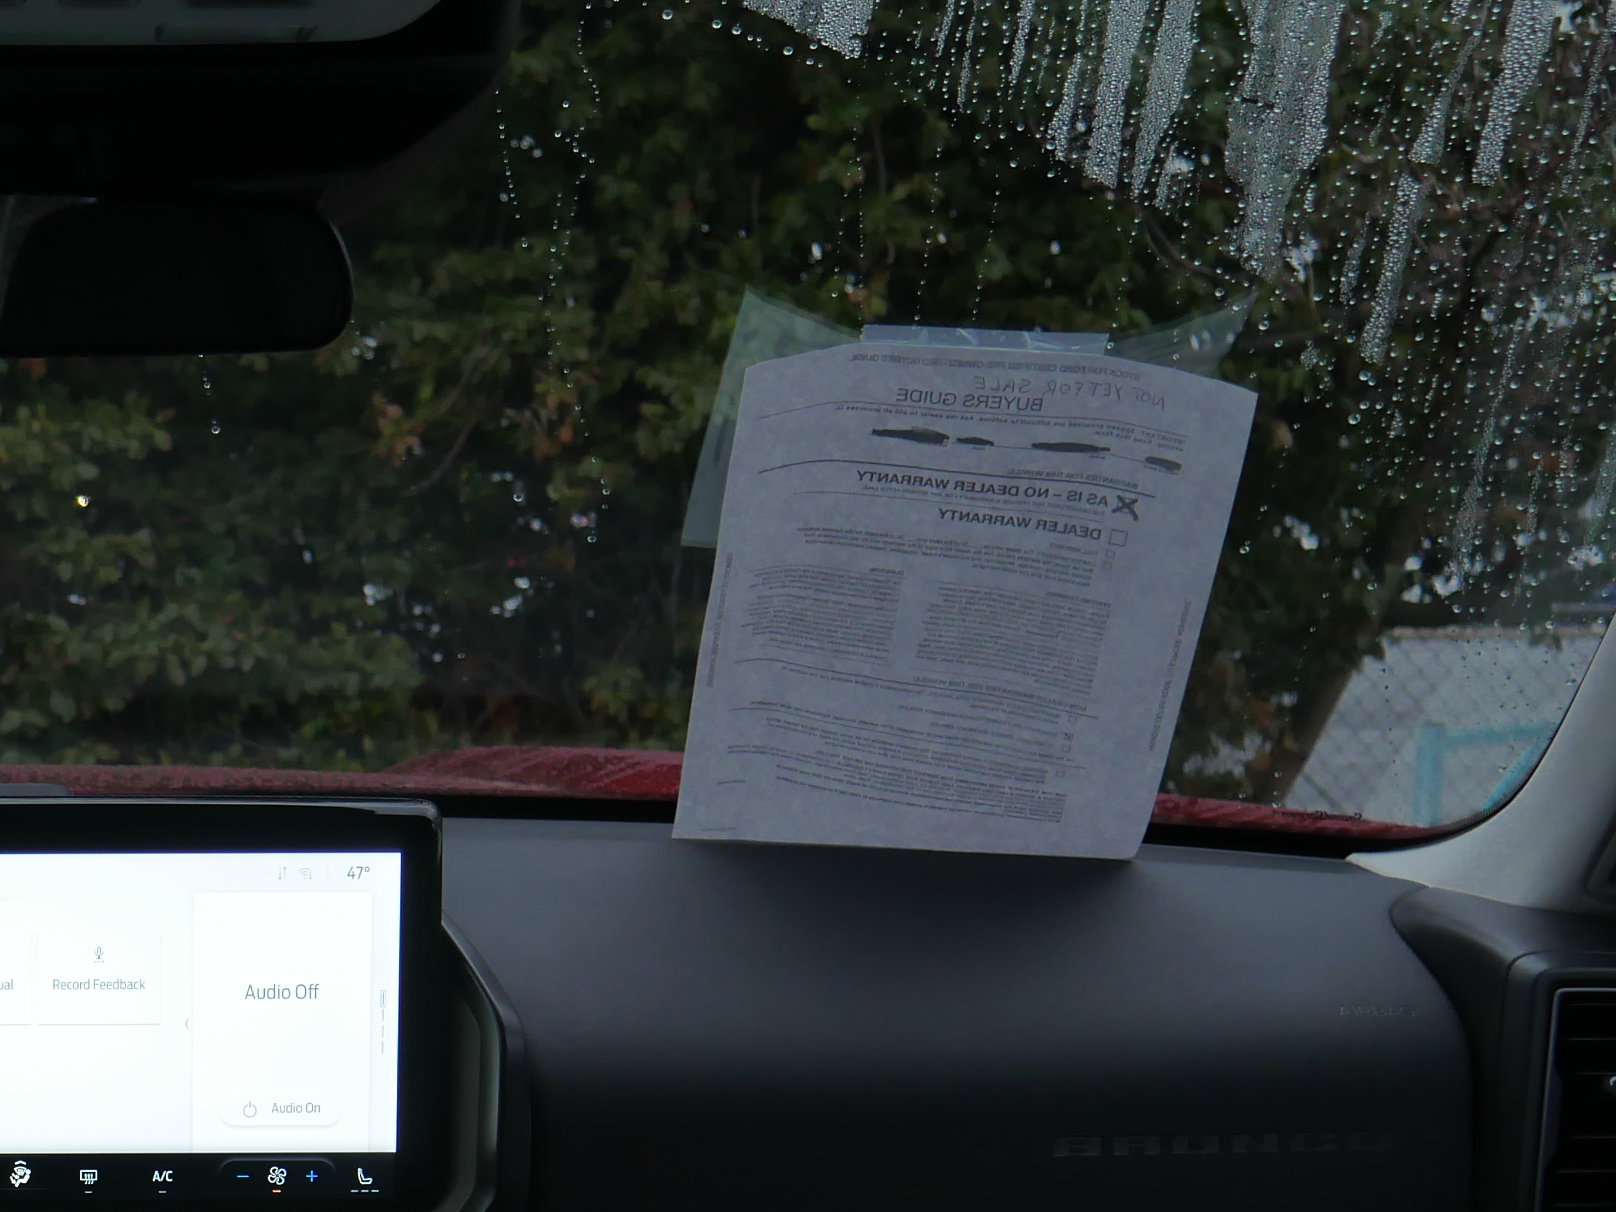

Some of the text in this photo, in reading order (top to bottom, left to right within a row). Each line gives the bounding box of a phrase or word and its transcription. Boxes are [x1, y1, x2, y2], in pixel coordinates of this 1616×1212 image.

[346, 866, 371, 880] 47°
[52, 978, 146, 990] Record Feedback
[244, 984, 320, 1000] Audio Off
[271, 1102, 321, 1114] Audio On
[1053, 1132, 1394, 1158] BRONCO
[152, 1170, 173, 1182] A/C
